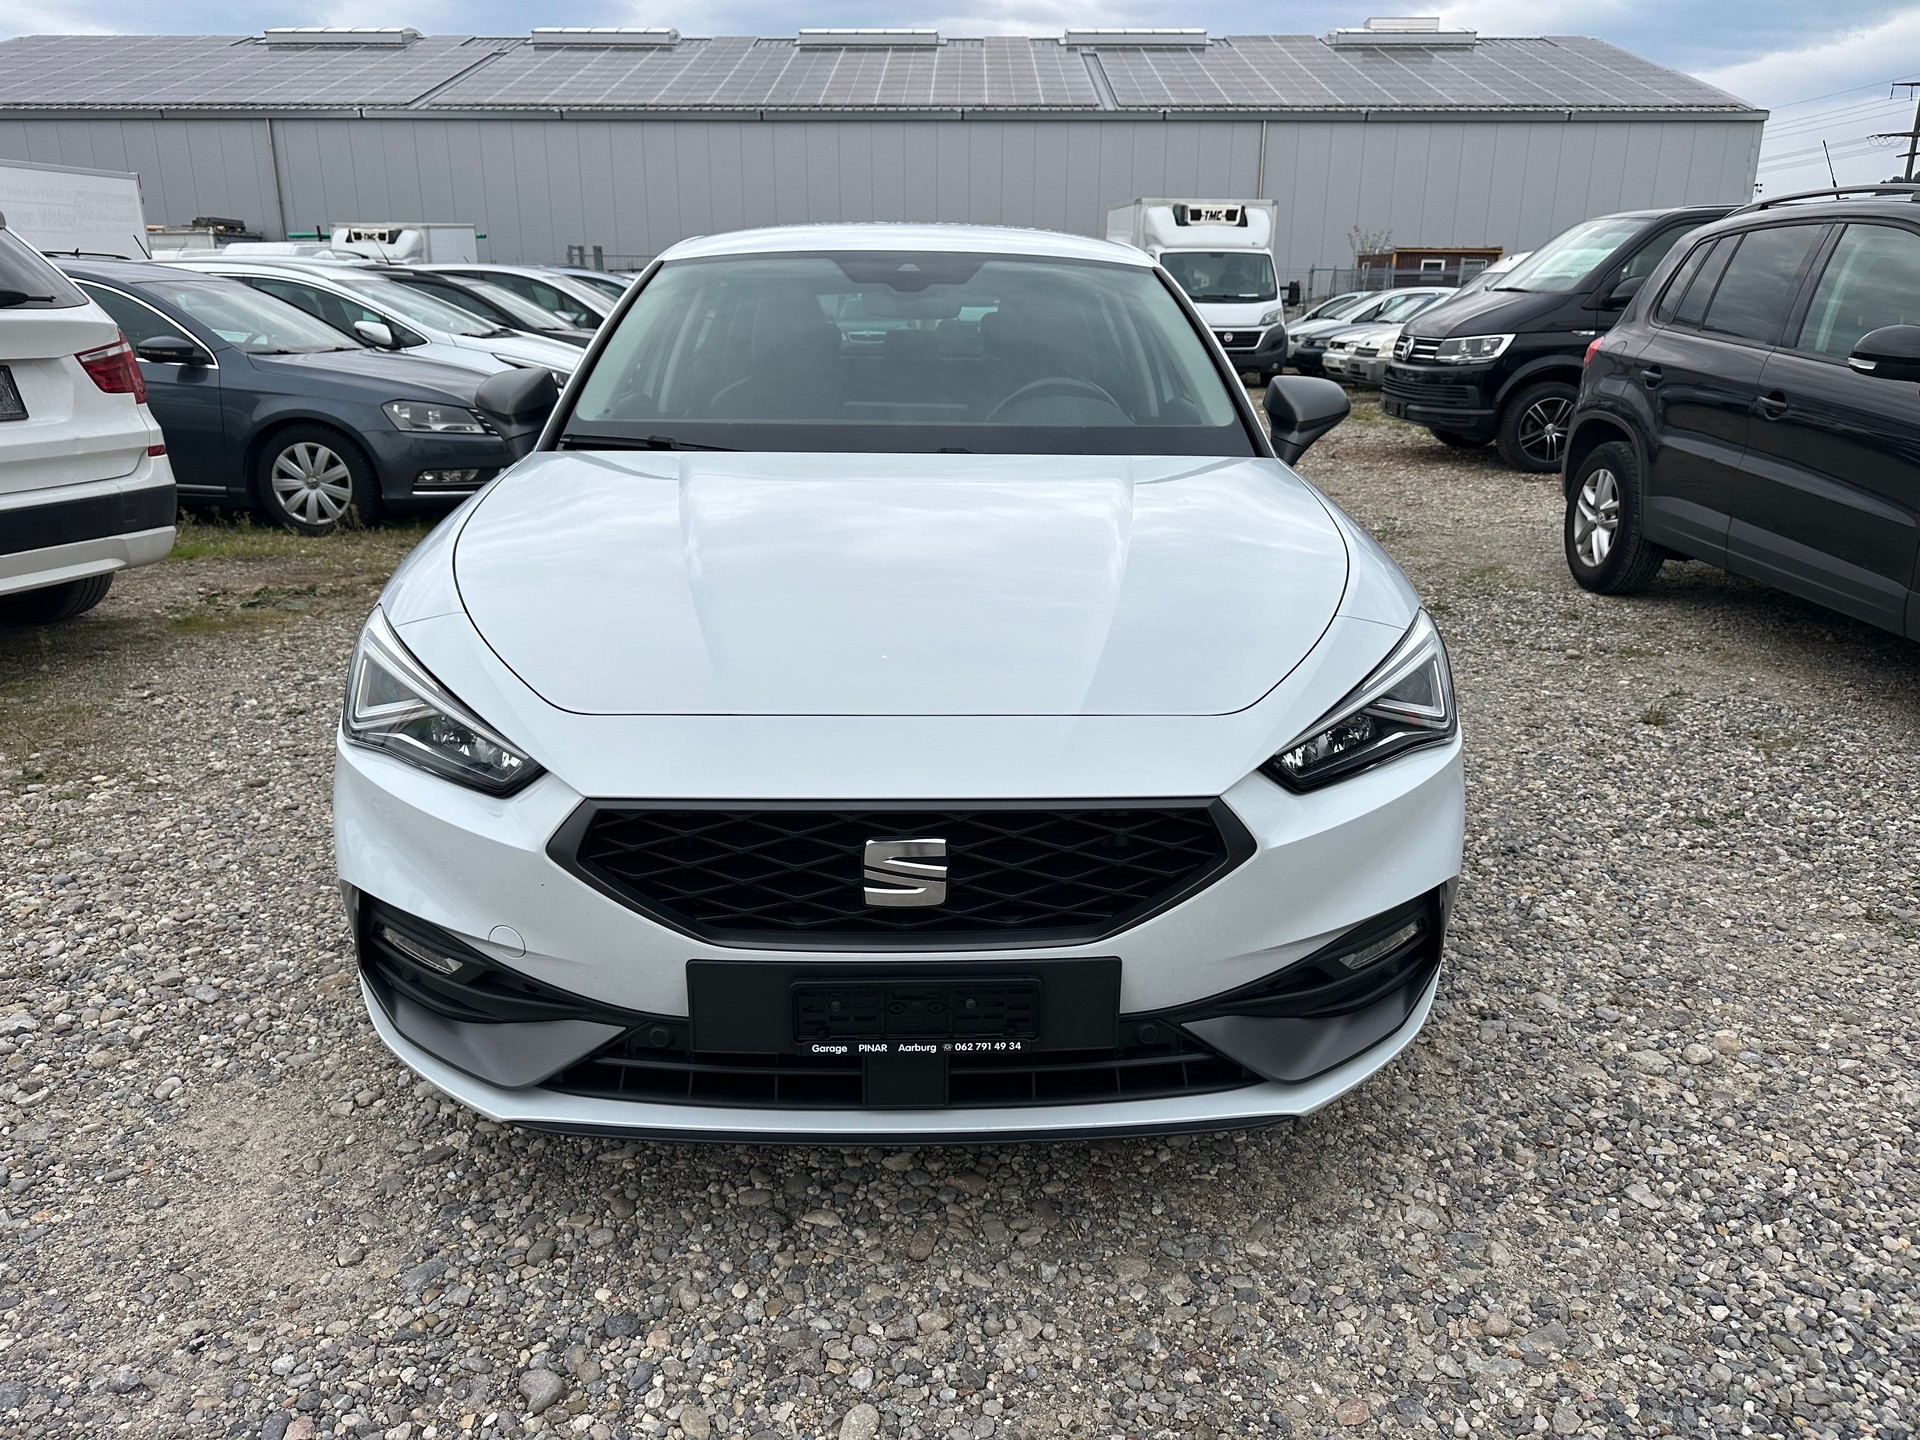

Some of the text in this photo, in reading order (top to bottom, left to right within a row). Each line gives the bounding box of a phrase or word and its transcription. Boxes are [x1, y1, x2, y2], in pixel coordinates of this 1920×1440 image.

[1204, 210, 1223, 221] TMC
[811, 1041, 1022, 1055] Garage PINAR Aarburg 062 791 49 34
